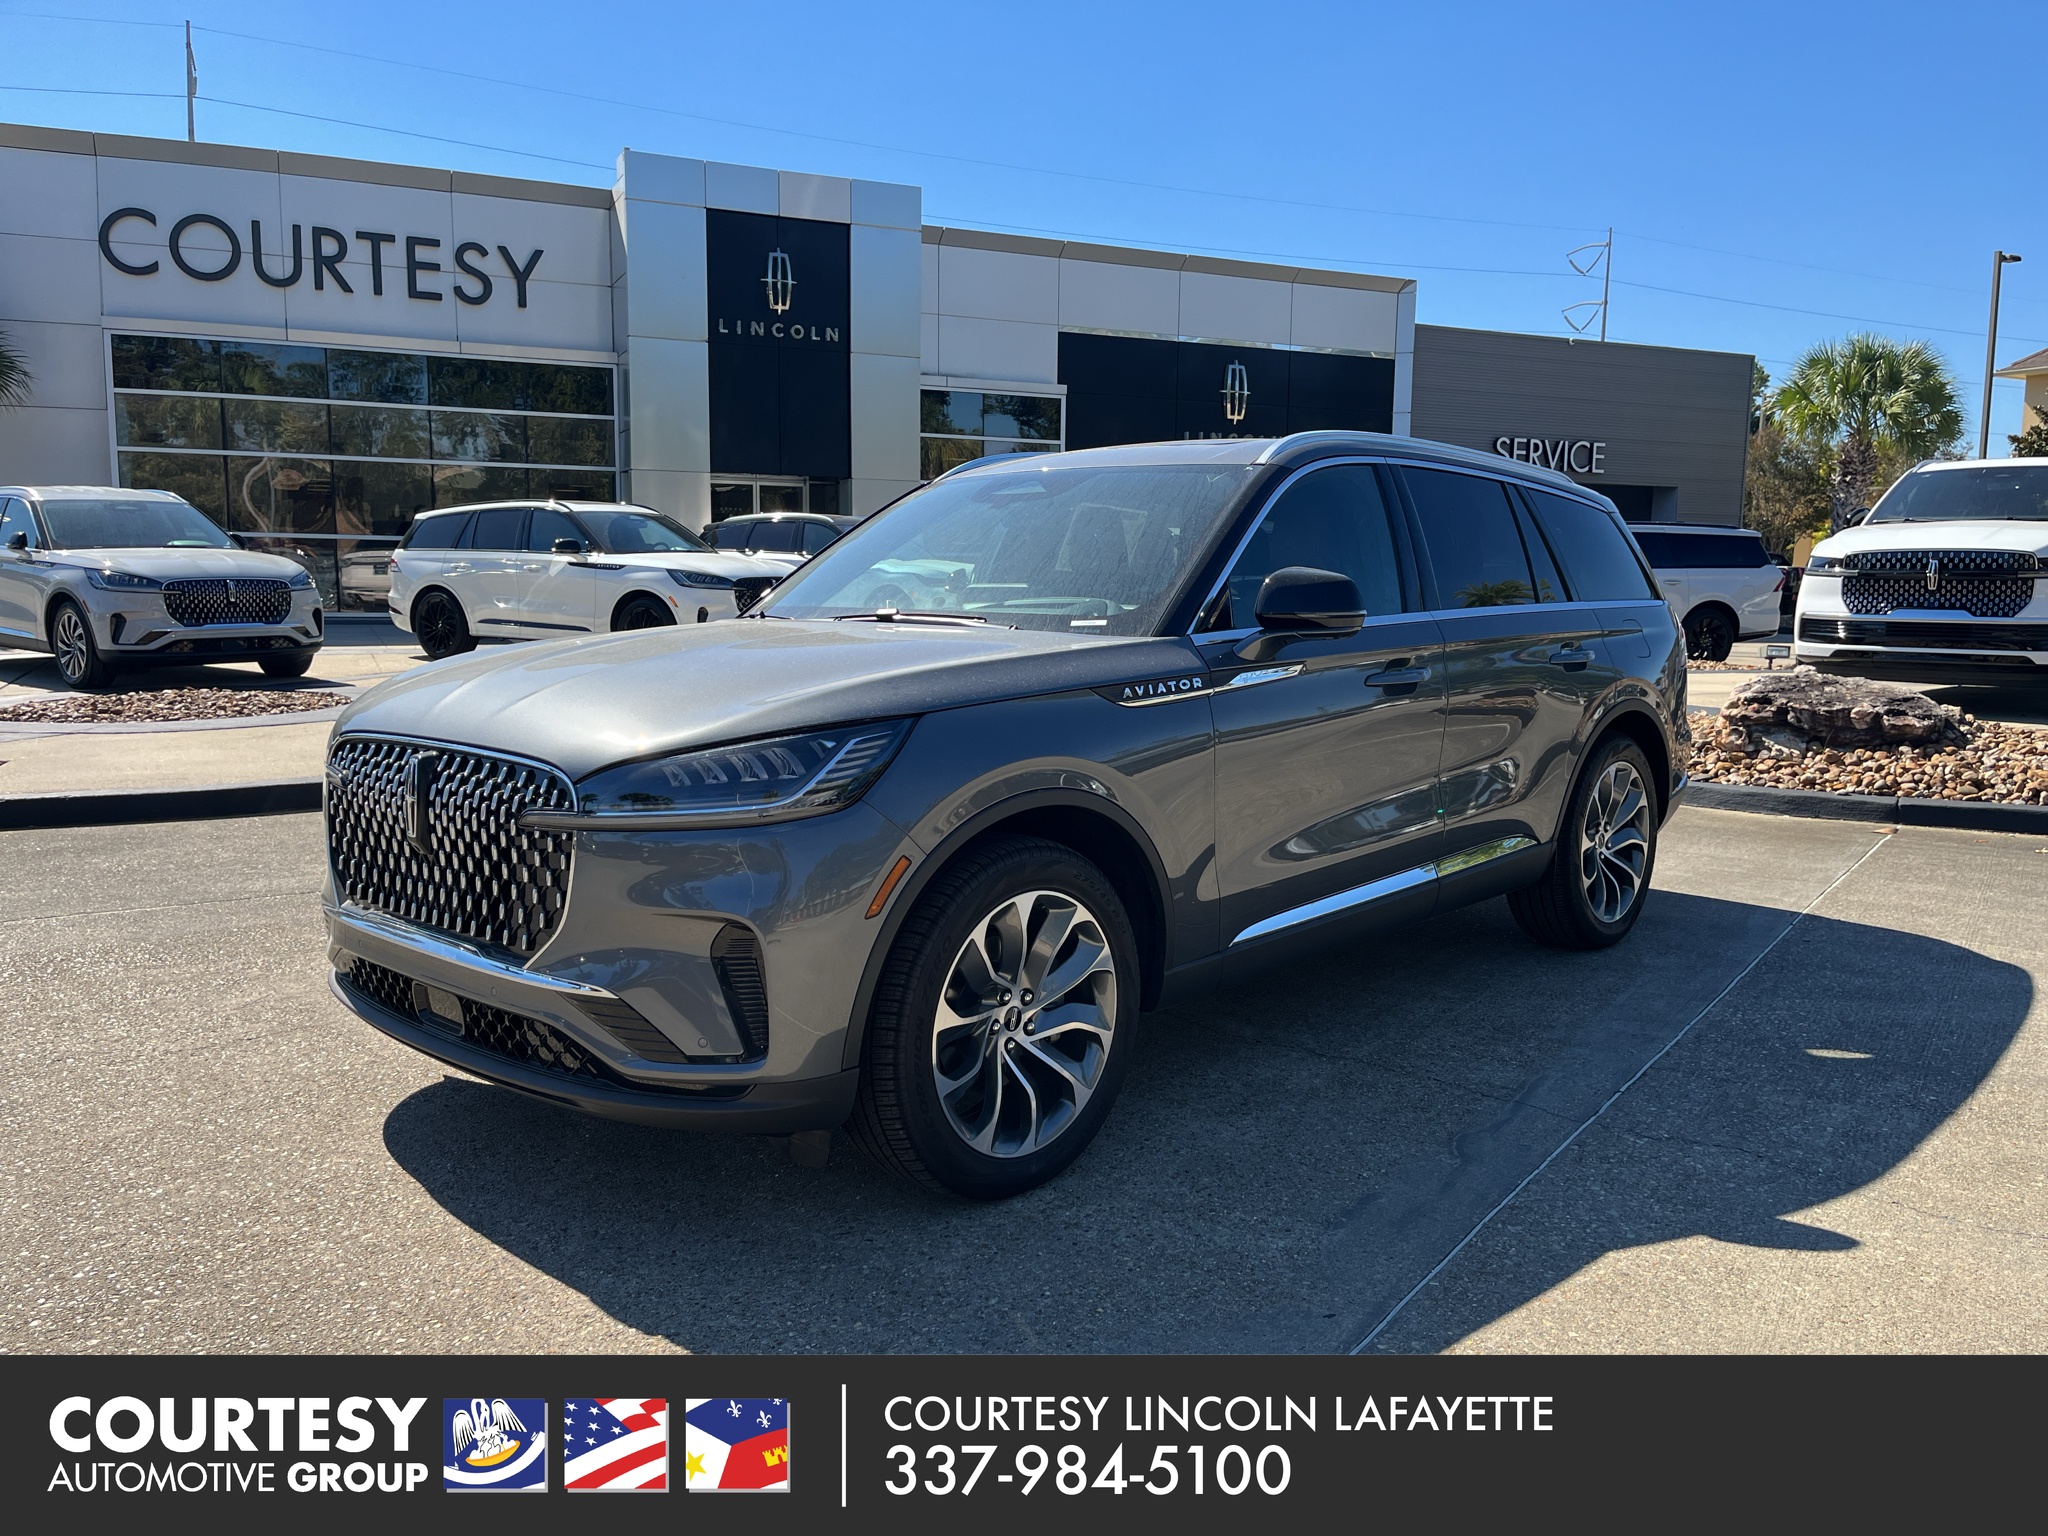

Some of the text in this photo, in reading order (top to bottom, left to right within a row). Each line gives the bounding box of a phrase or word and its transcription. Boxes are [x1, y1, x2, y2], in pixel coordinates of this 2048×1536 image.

[99, 207, 545, 309] COURTESY
[718, 318, 839, 342] LINCOLN
[1496, 437, 1606, 474] SERVICE
[1123, 677, 1203, 699] AVIATOR
